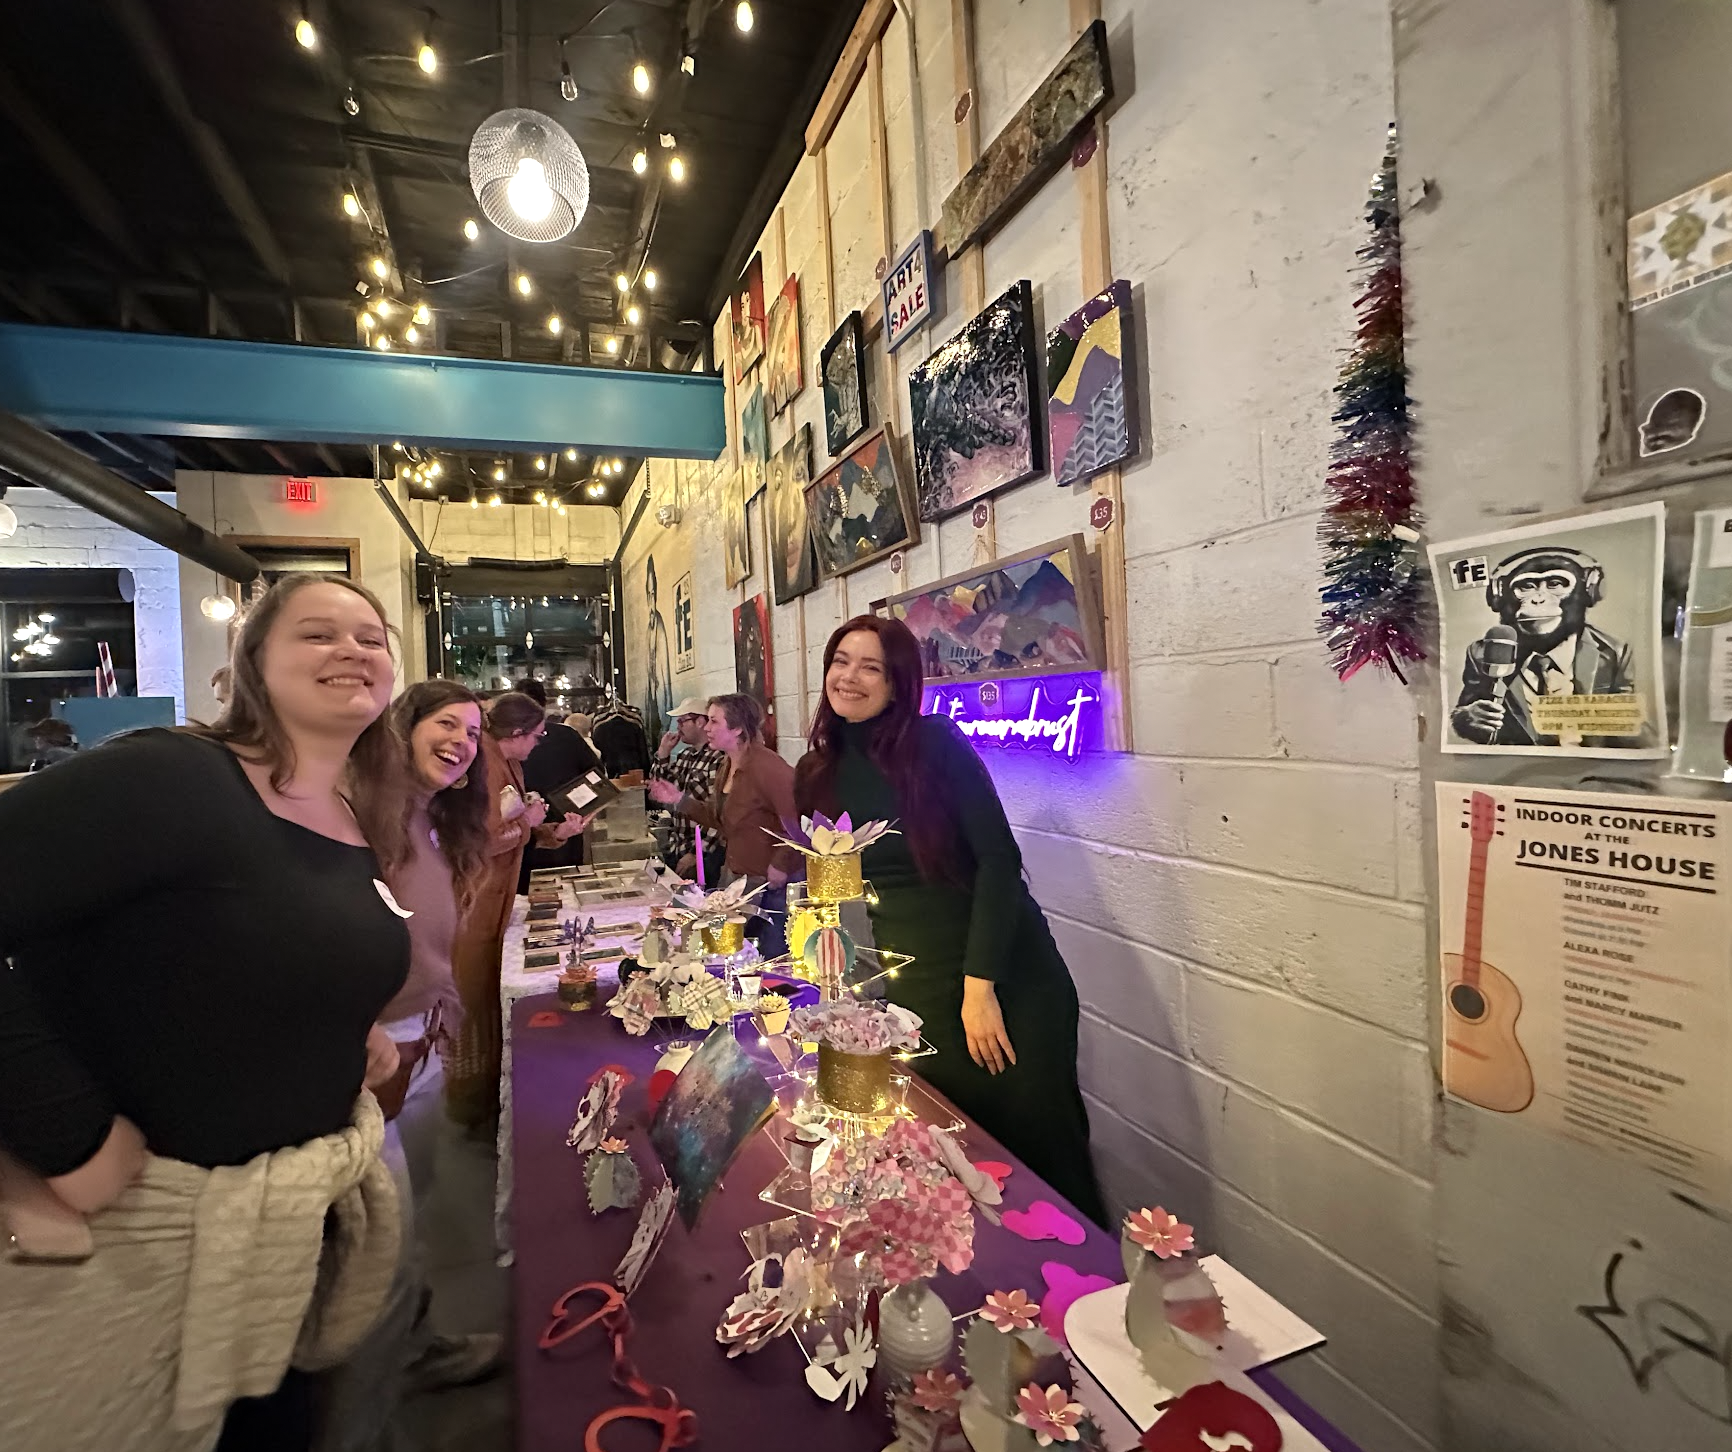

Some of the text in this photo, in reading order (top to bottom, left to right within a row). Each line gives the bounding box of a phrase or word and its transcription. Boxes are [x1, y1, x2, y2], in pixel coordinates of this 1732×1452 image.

[891, 283, 924, 334] SALE
[287, 481, 312, 500] EXIT
[1536, 709, 1590, 718] THURSDAY
[1516, 808, 1716, 838] INDOOR CONCERTS
[1584, 832, 1630, 845] AT THE
[1517, 840, 1716, 880] JONES HOUSE
[1563, 893, 1582, 902] and
[1564, 878, 1646, 898] TIM STAFFORD
[1563, 941, 1634, 963] ALEXA ROSE
[1564, 980, 1600, 994] CATHY
